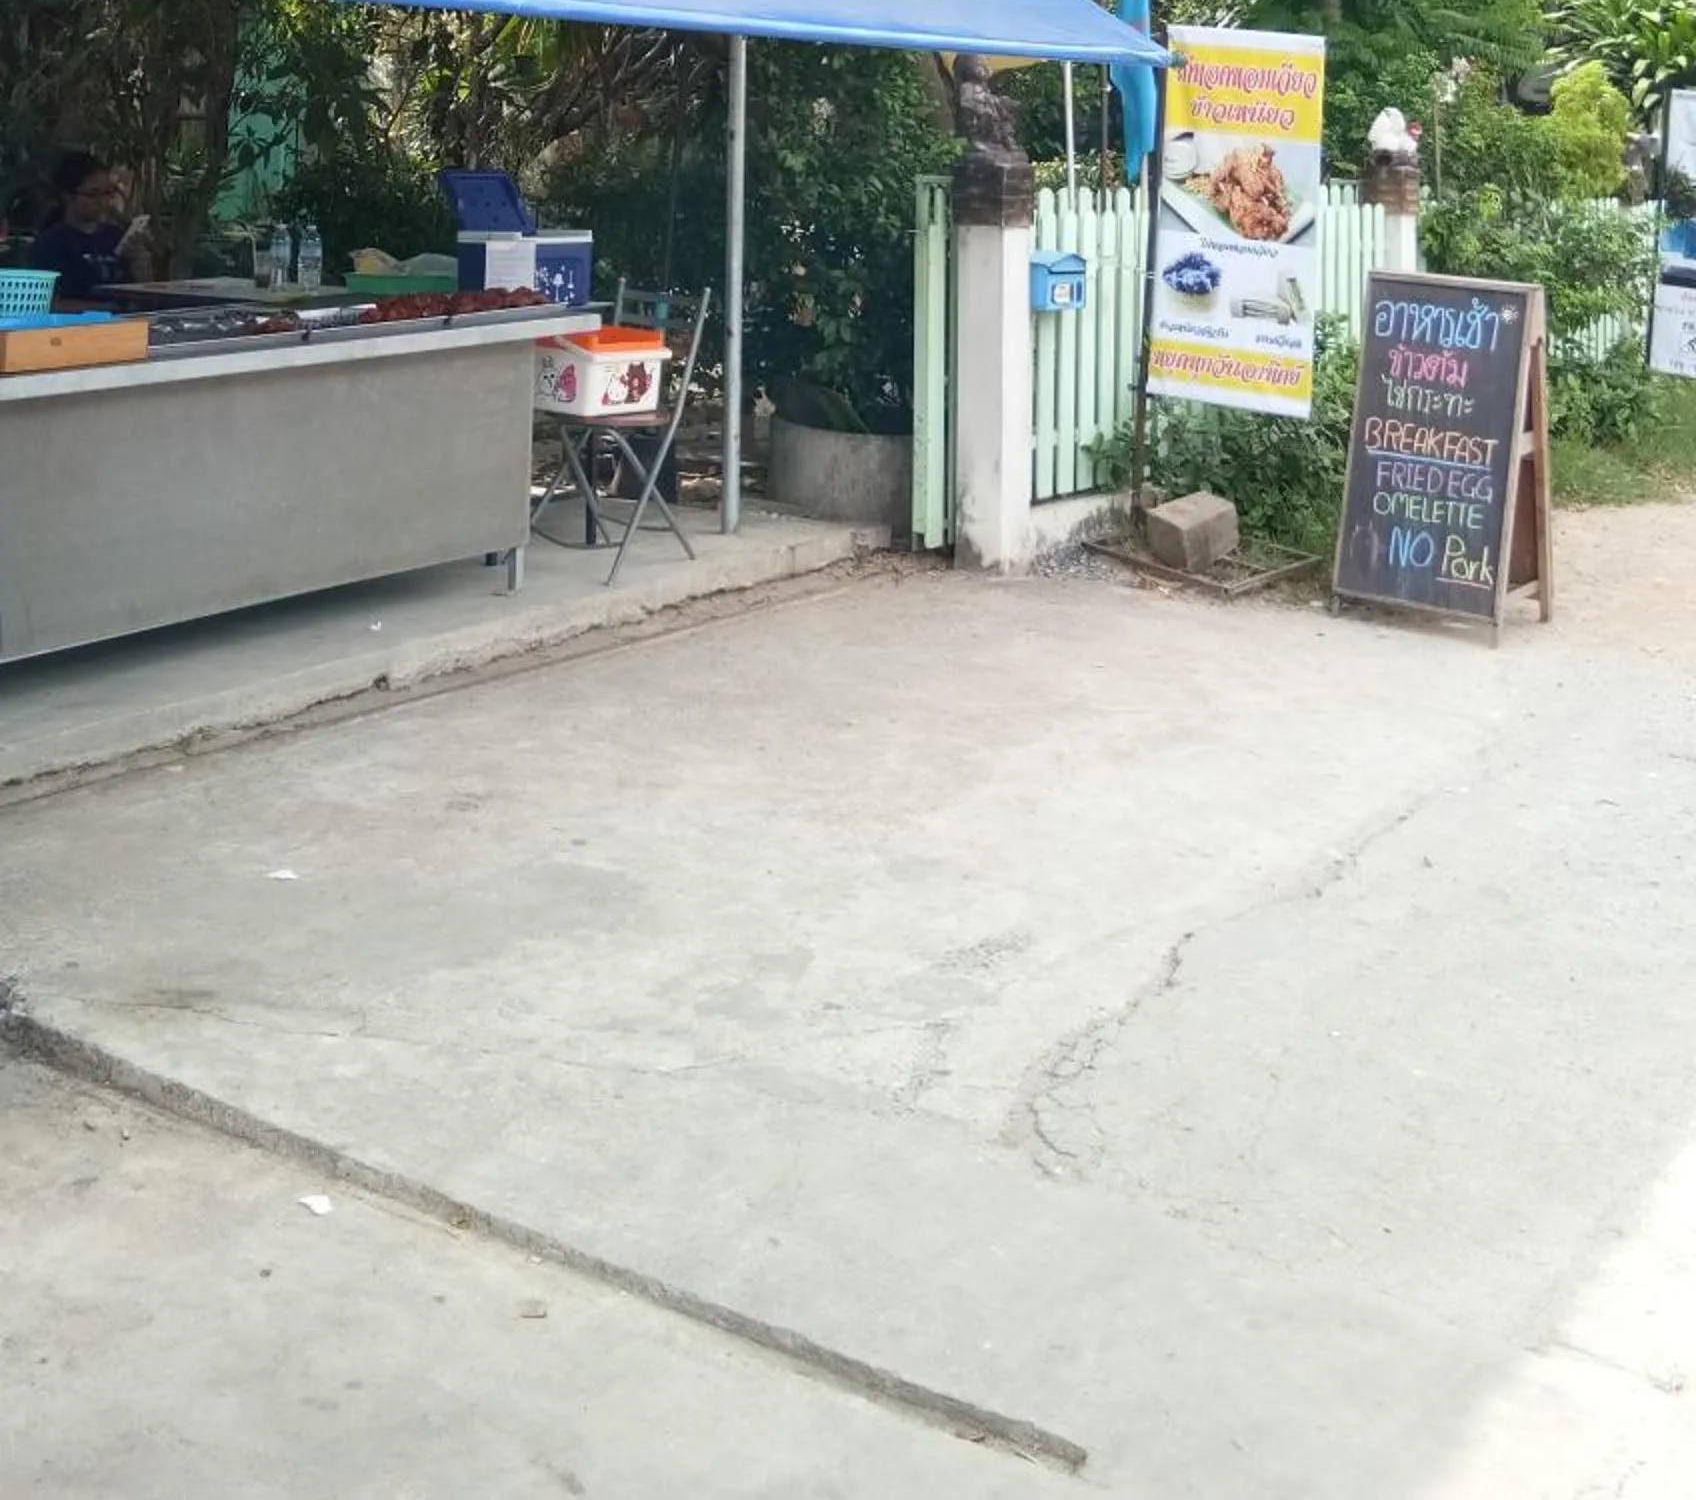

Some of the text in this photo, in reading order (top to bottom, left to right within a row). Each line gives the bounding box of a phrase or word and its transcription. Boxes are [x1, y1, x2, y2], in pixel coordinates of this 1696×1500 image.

[1375, 297, 1499, 353] อาหารเช้า
[1388, 343, 1468, 388] ข้าวต้ม
[1380, 373, 1475, 417] ไข่กระทะ
[1365, 416, 1499, 467] BREAKFAST
[1377, 461, 1493, 505] FRIED EGG
[1373, 492, 1484, 529] OMELETTE
[1389, 526, 1435, 568] NO
